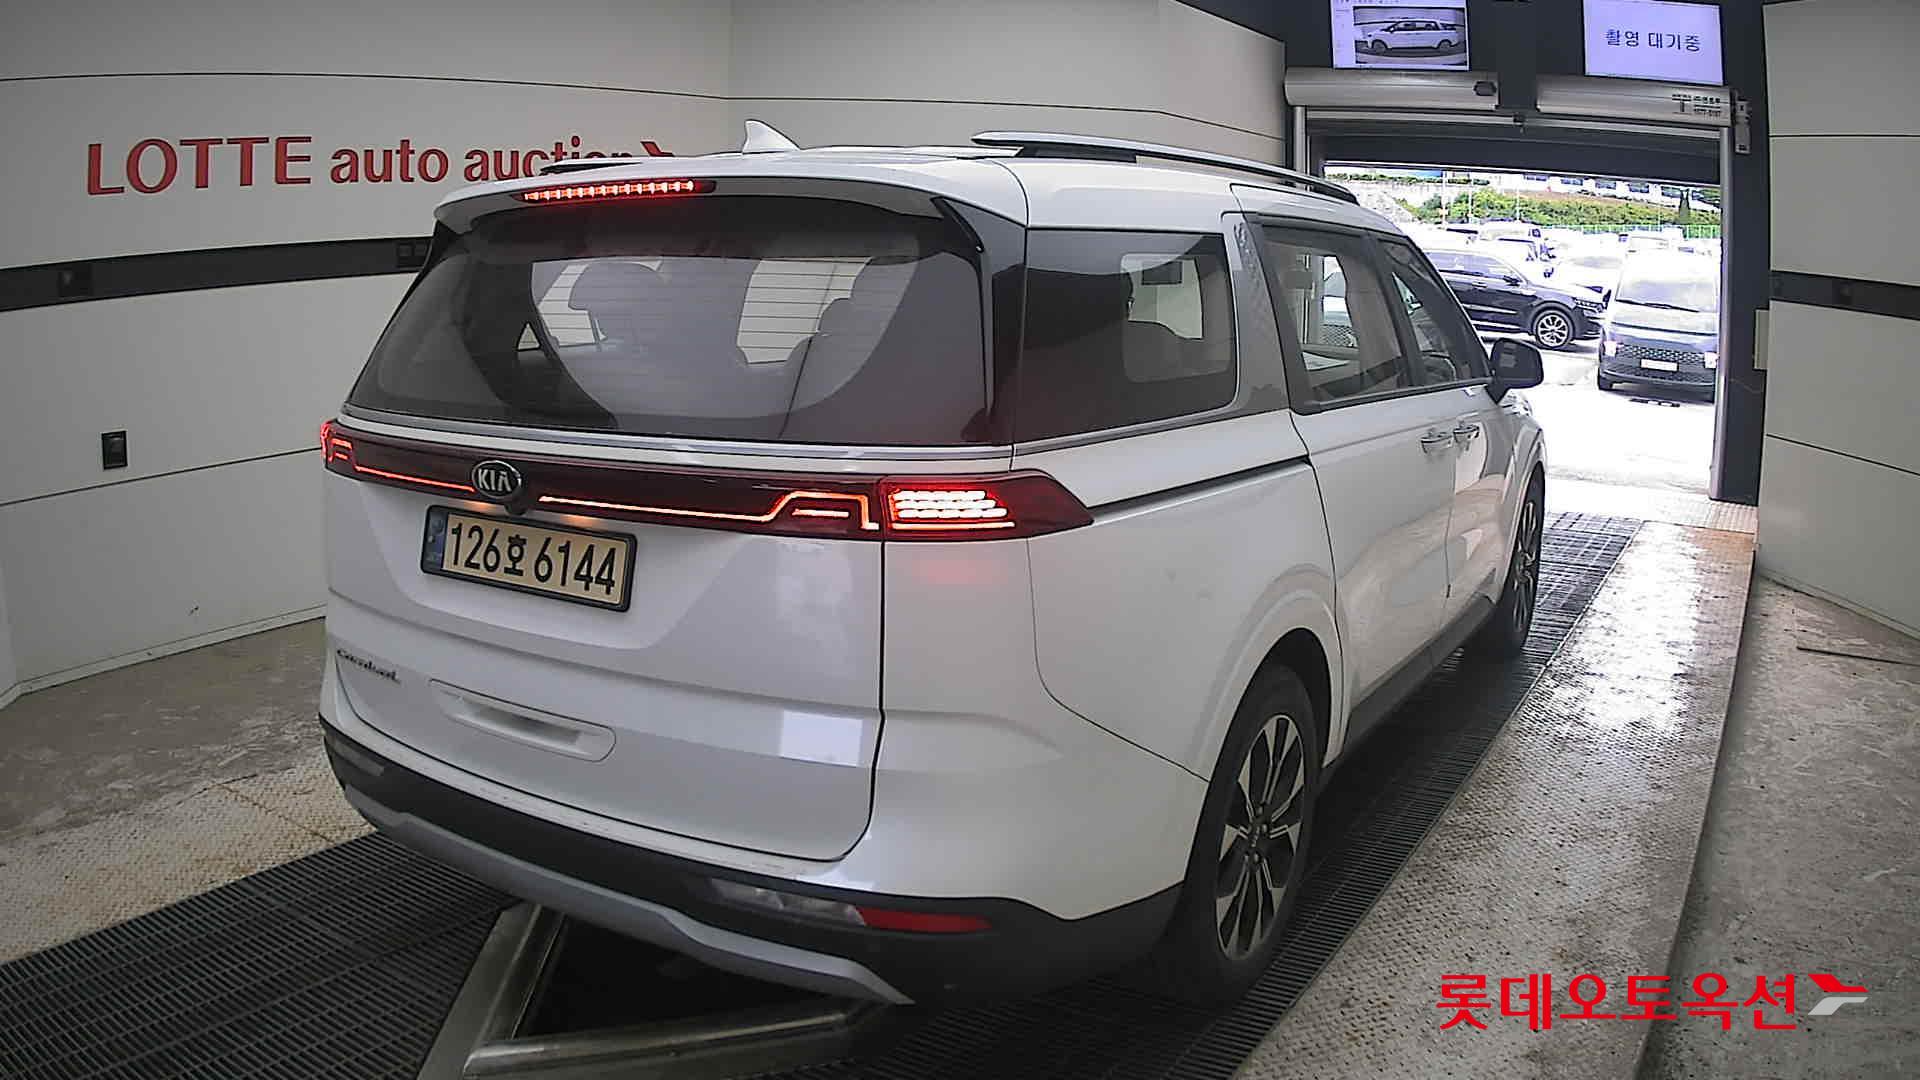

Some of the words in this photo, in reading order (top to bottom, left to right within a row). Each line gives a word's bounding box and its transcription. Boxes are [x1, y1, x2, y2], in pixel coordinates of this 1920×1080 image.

[1648, 32, 1700, 52] 대기중
[87, 136, 312, 195] LOTTE
[330, 139, 449, 183] auto
[451, 522, 527, 577] 126호
[534, 536, 616, 595] 6144
